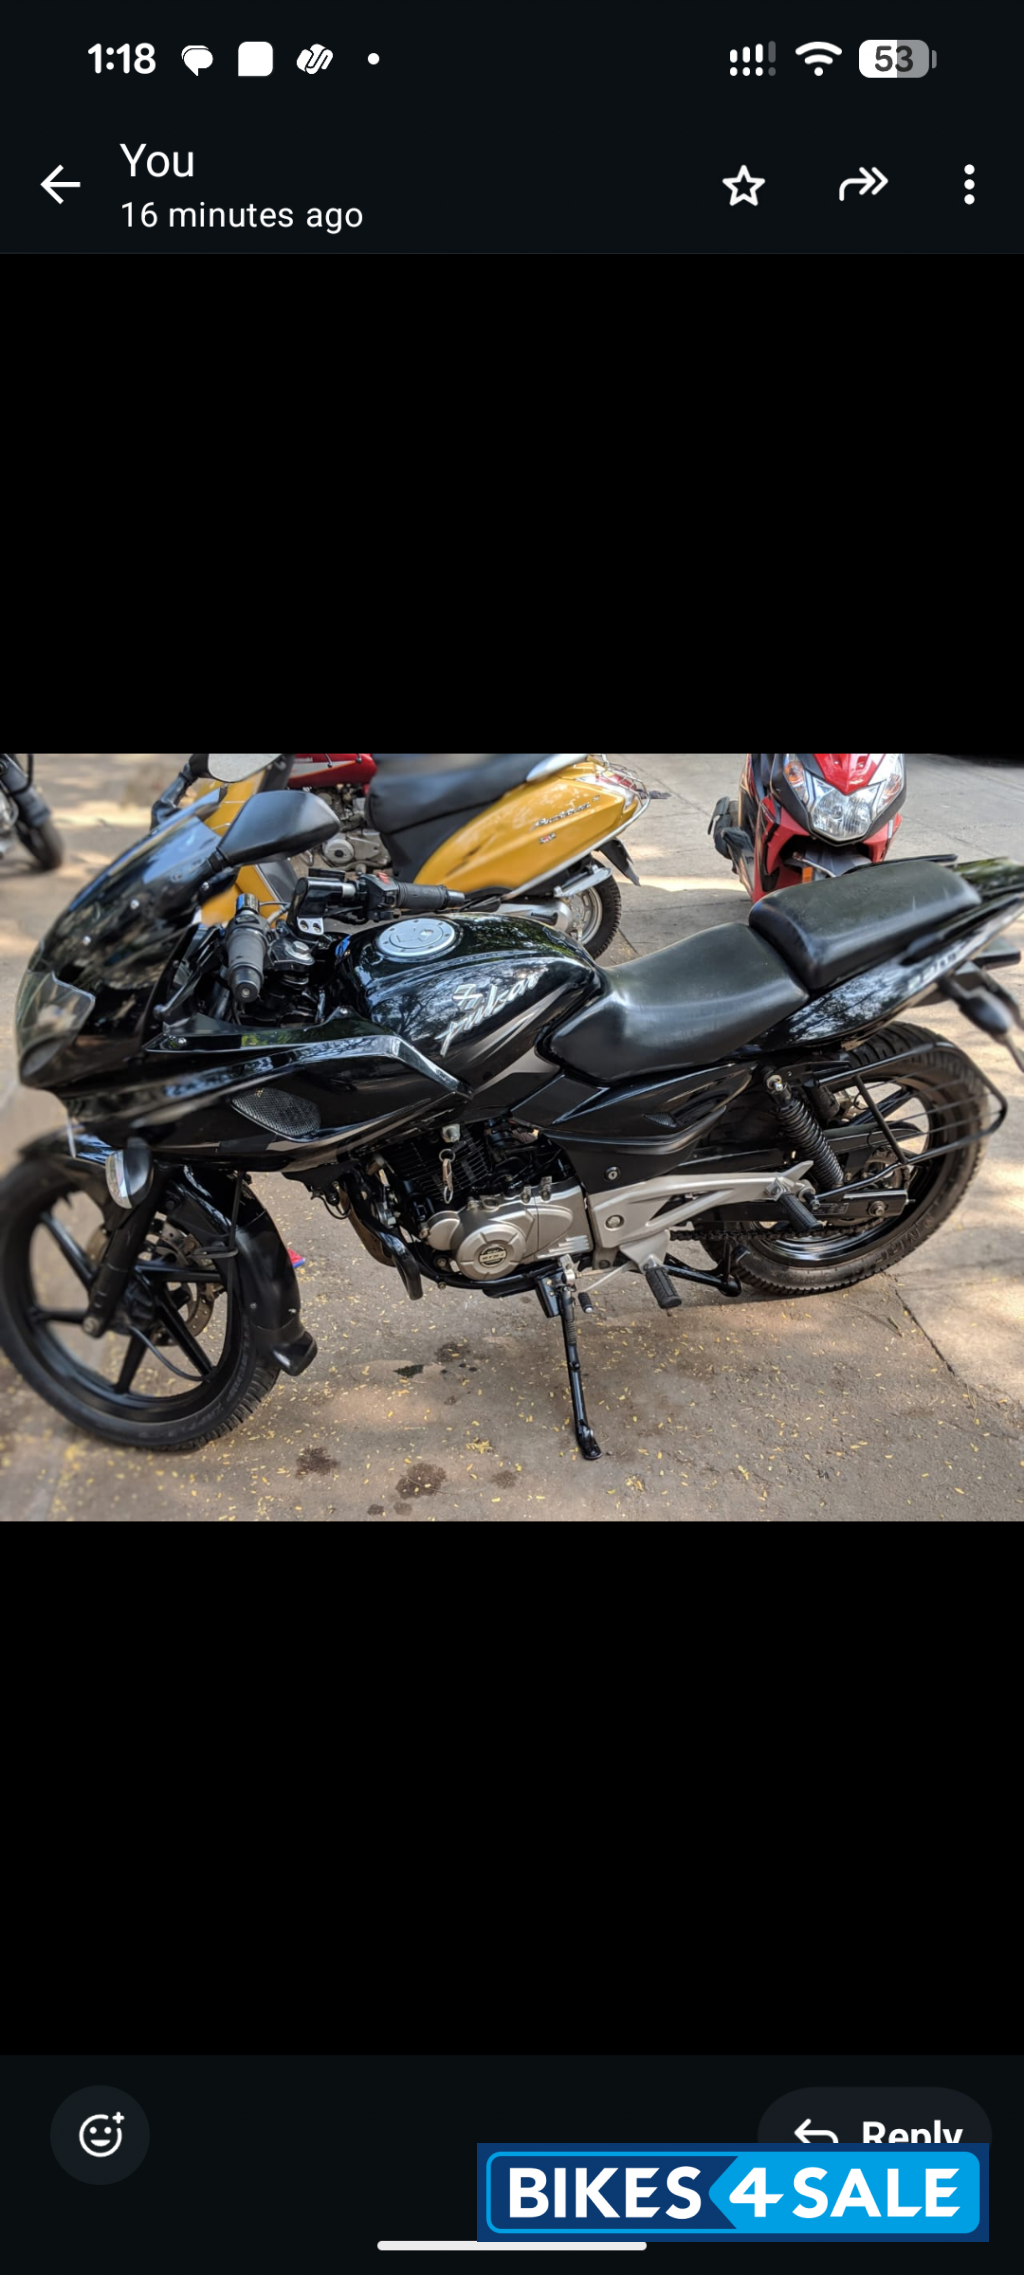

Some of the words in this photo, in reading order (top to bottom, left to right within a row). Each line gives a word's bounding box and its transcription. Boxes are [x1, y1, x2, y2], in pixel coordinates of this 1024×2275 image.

[87, 42, 157, 75] 1:18
[873, 45, 914, 73] 53
[119, 143, 195, 178] You
[121, 201, 158, 228] 16
[169, 201, 294, 228] minutes
[306, 206, 364, 235] ago
